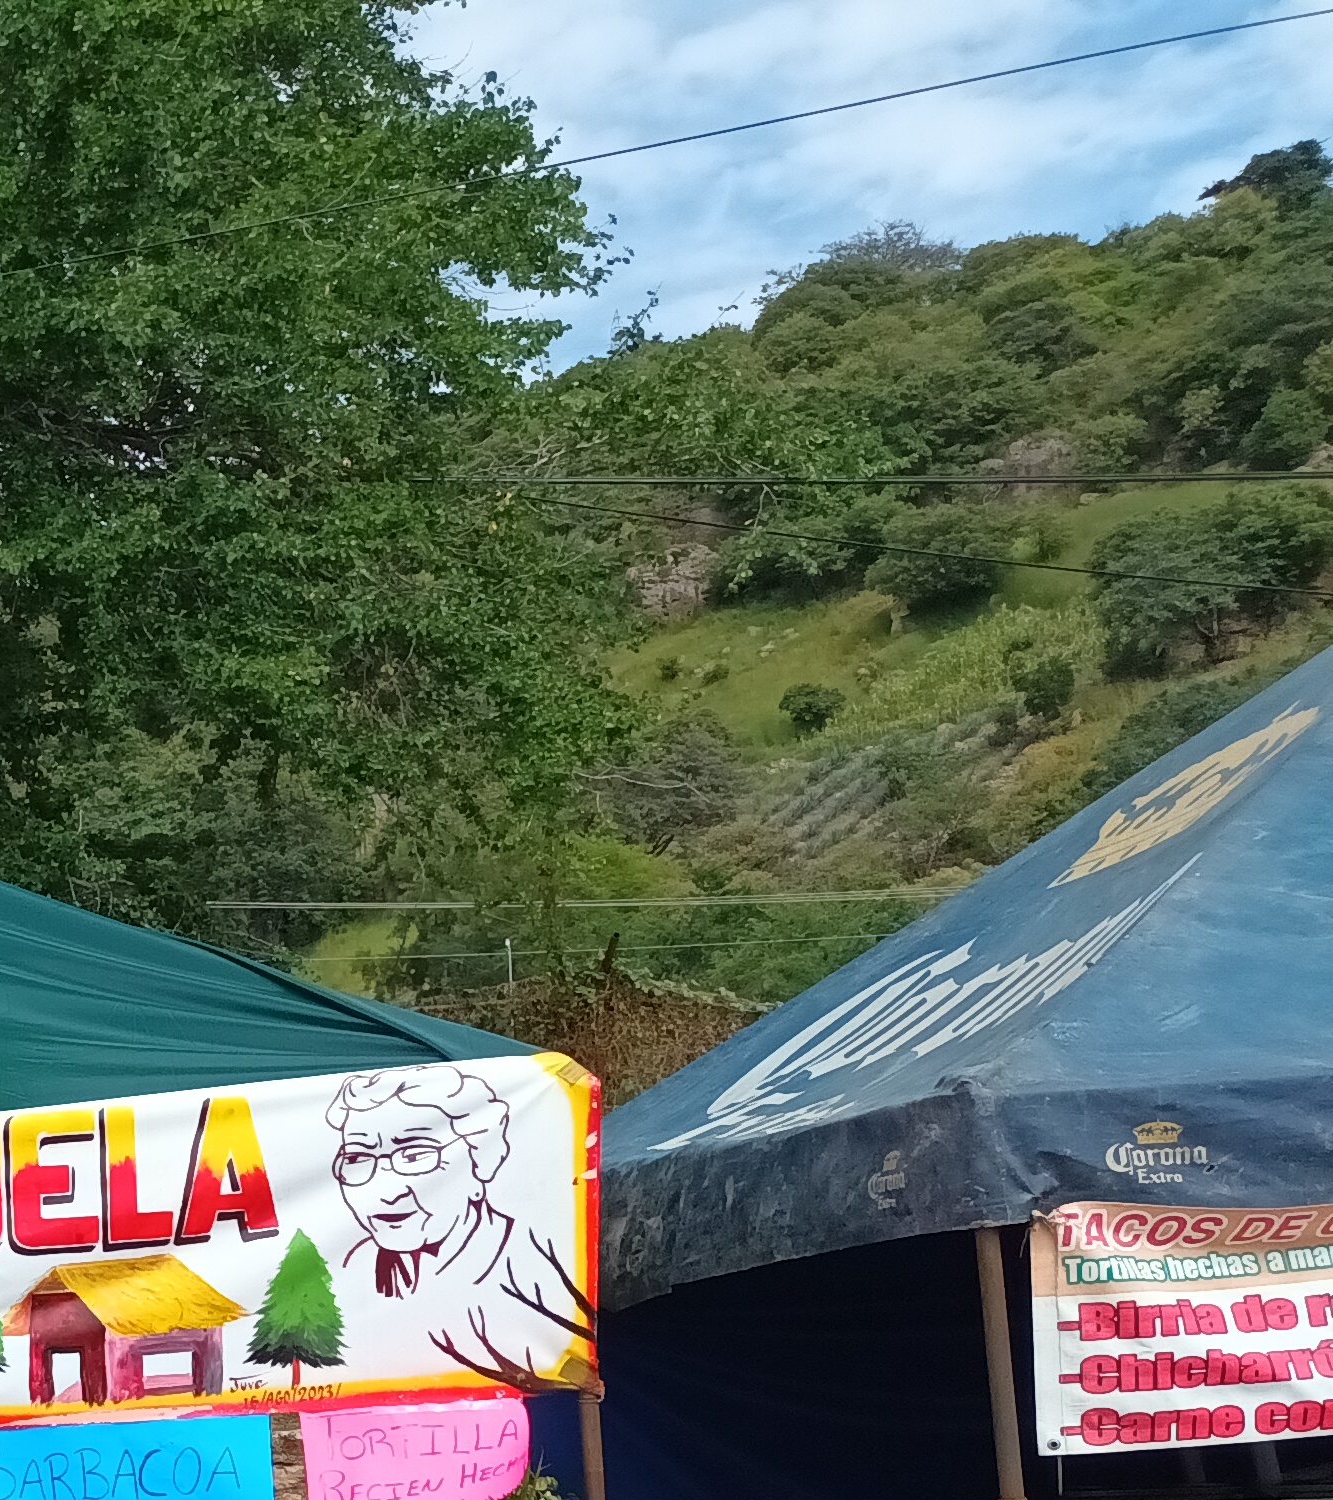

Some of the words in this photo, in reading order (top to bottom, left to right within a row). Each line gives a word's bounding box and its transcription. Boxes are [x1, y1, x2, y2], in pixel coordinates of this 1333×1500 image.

[1105, 1142, 1210, 1174] Corona
[1137, 1168, 1183, 1184] Extra
[1059, 1210, 1227, 1249] TACOS
[1227, 1212, 1317, 1244] DE
[1063, 1255, 1166, 1285] Tortillas
[1165, 1248, 1260, 1282] hechas
[1265, 1249, 1288, 1274] a
[1230, 1294, 1298, 1333] de
